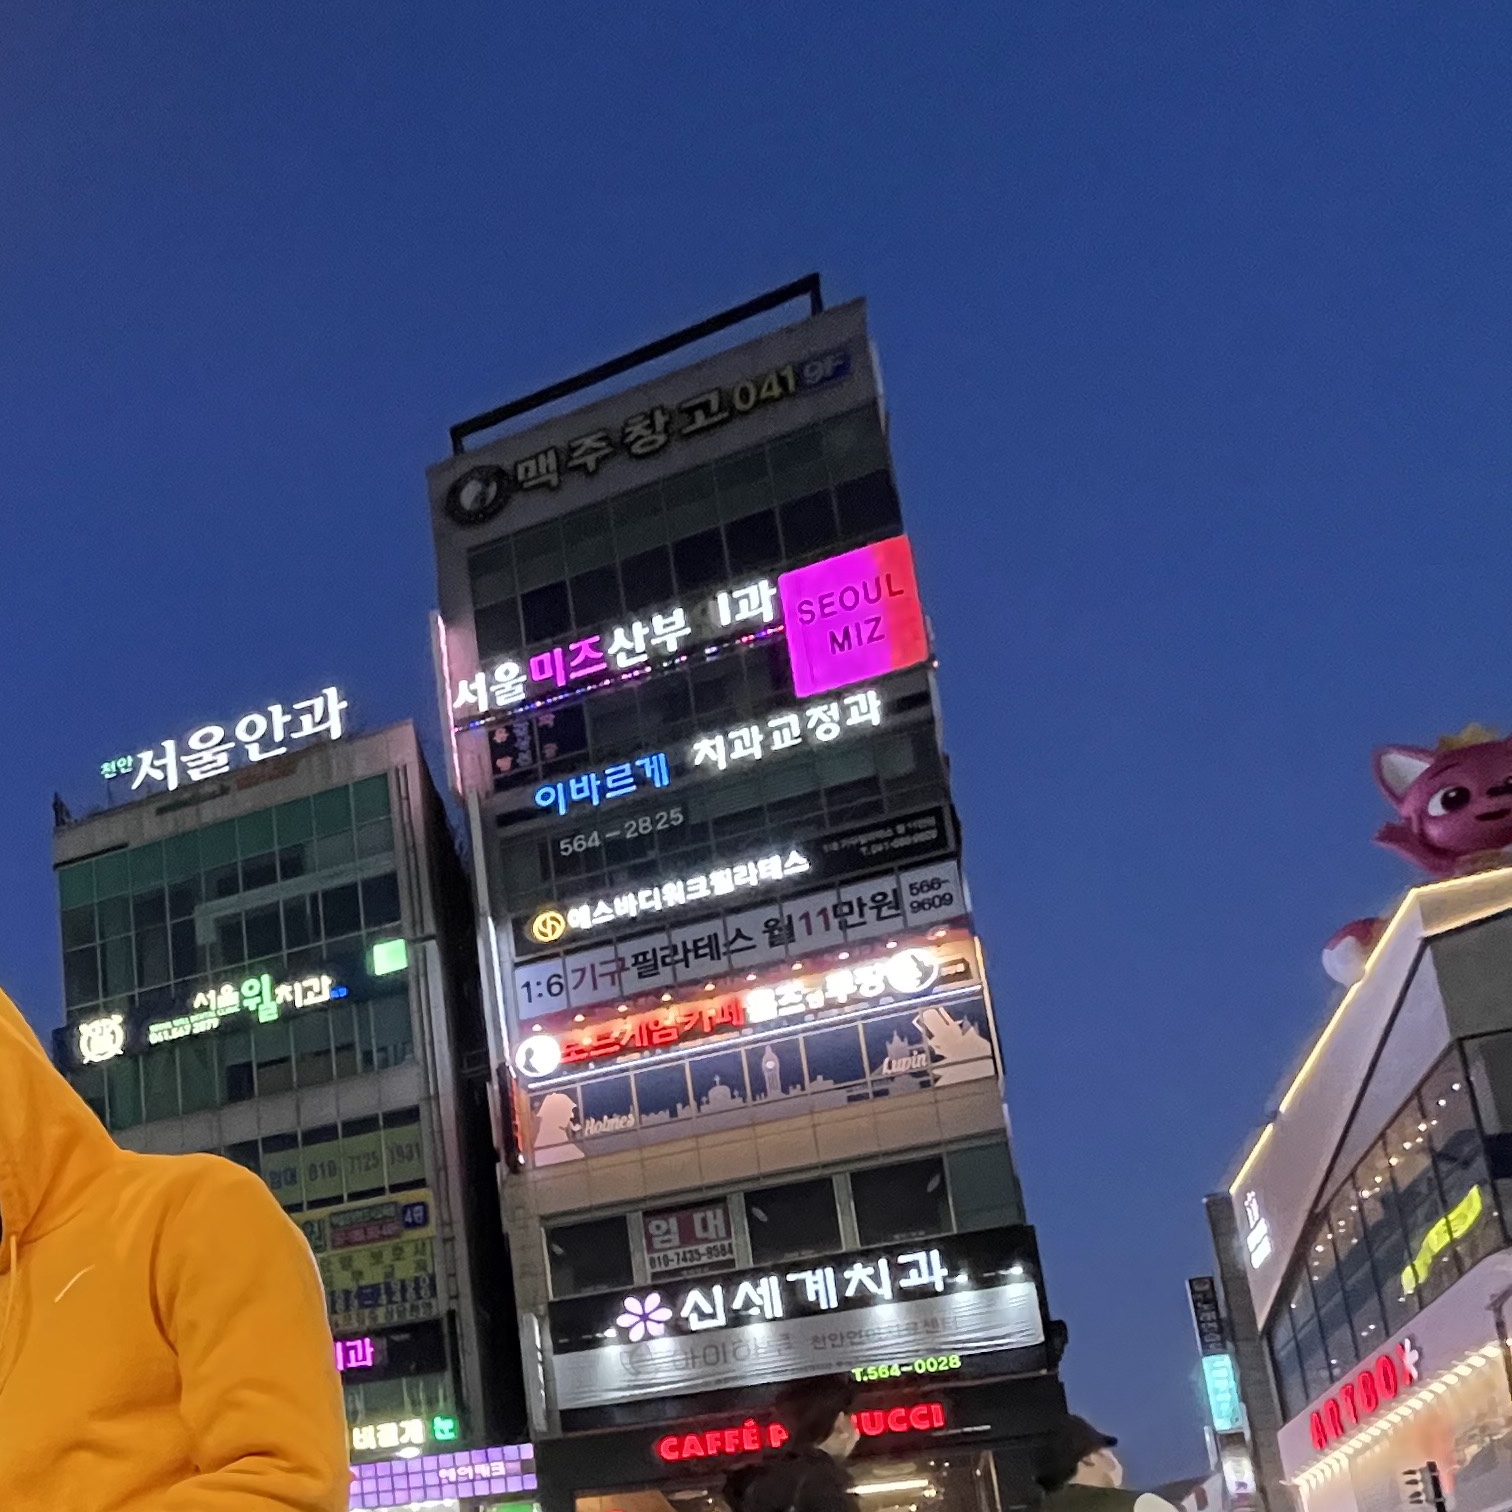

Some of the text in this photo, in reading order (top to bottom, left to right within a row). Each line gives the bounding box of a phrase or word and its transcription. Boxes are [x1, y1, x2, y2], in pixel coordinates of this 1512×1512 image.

[516, 392, 730, 490] 맥주창고
[732, 365, 797, 411] 041
[796, 572, 906, 626] SEOUL
[827, 616, 887, 656] MIZ
[131, 686, 349, 793] 서울안과
[533, 689, 884, 817] 이바르게 치과교정과
[558, 808, 686, 858] 564-2825
[908, 876, 950, 897] 566-
[908, 891, 953, 914] 9609
[519, 972, 566, 1005] 1:6
[647, 1207, 728, 1250] 임대
[681, 1248, 950, 1333] 신세계치과
[851, 1353, 962, 1382] T.564-0028
[660, 1418, 762, 1462] CAFFÉ
